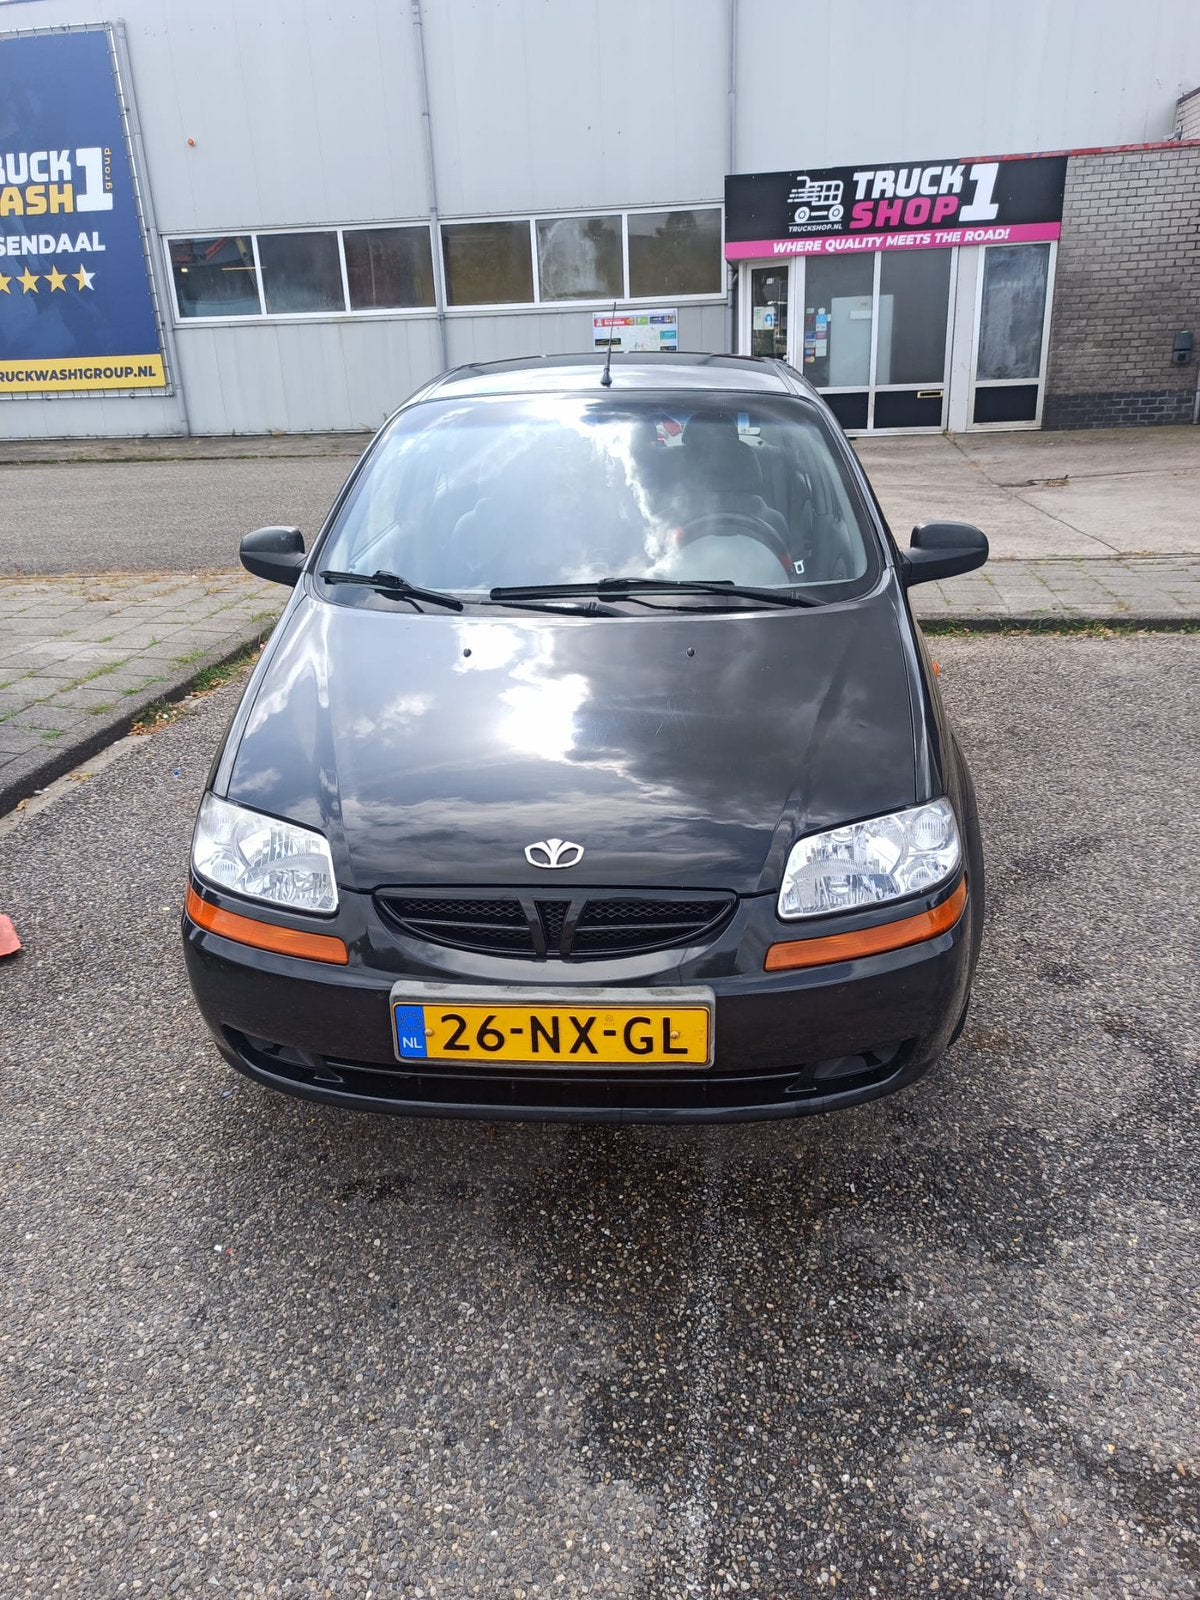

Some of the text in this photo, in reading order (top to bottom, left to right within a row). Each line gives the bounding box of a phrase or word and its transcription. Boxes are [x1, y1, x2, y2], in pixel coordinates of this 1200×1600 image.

[0, 147, 114, 212] UCK 1
[104, 147, 113, 190] group
[853, 162, 1000, 222] TRUCK 1
[788, 223, 844, 234] TRUCKSHOP.NL
[849, 196, 960, 230] SHOP
[773, 228, 1011, 254] WHERE QUALITY MEETS THE ROAD!
[402, 1036, 422, 1050] NL
[440, 1013, 688, 1055] 26-NX-GL
